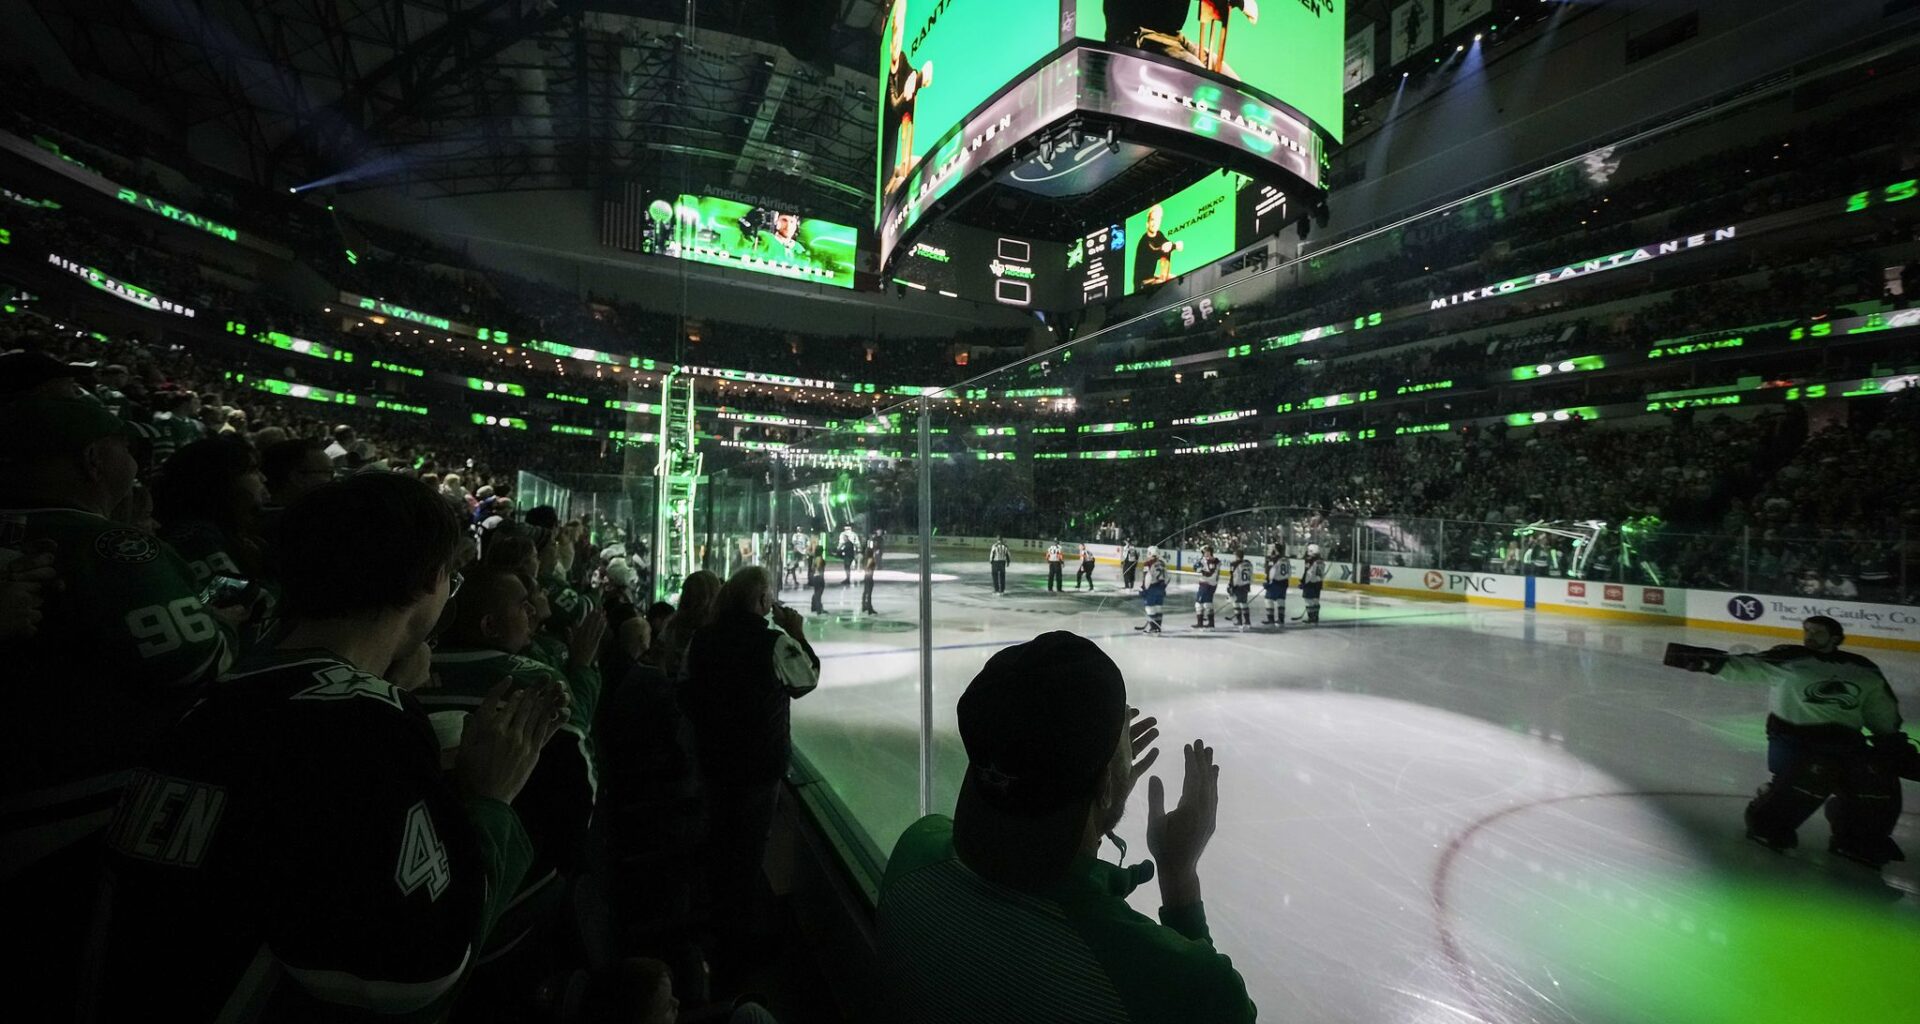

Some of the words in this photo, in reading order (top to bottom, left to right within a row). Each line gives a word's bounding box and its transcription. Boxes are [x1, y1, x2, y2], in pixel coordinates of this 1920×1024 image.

[1137, 84, 1208, 113] MIKKO
[1220, 109, 1306, 157] RANTANEN
[703, 184, 758, 205] American
[759, 196, 800, 214] Airlines
[1199, 195, 1225, 213] MIKKO
[1168, 208, 1215, 236] RANTANEN
[1431, 282, 1515, 310] MIKKO
[1535, 226, 1736, 286] RANTANEN
[49, 253, 99, 282] MIKKO
[106, 280, 195, 318] RANTANEN
[745, 372, 835, 389] RANTANEN
[1449, 574, 1496, 594] PNC
[125, 597, 216, 658] 96
[1770, 601, 1798, 613] The
[1802, 605, 1884, 625] McCauley
[1888, 611, 1918, 625] Co.
[395, 801, 451, 902] 4
